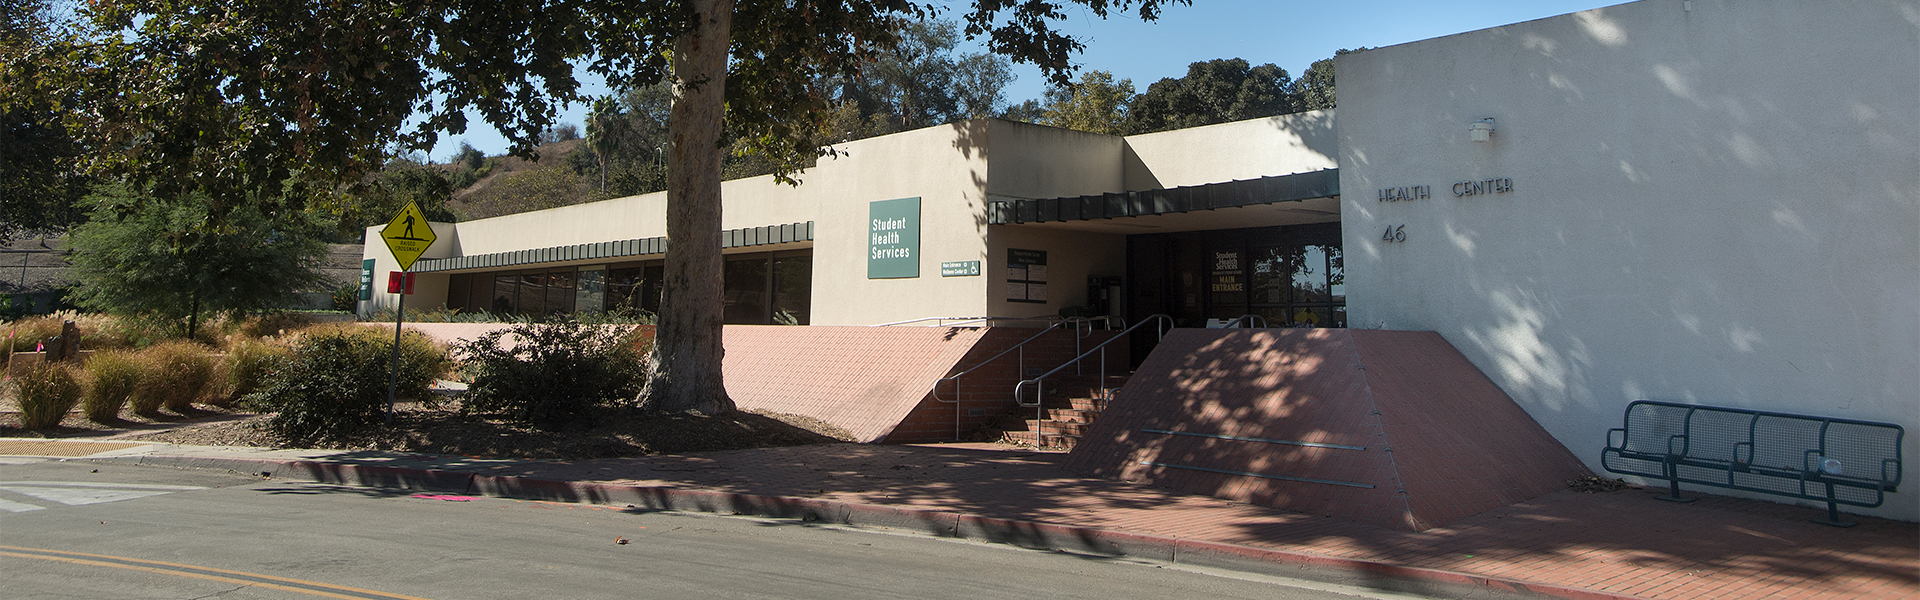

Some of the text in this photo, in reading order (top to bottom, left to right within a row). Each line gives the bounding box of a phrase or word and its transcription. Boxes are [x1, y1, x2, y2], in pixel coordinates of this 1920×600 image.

[1378, 177, 1513, 202] HEALTH CENTER
[872, 217, 906, 231] Student
[872, 231, 900, 245] Health
[1382, 224, 1406, 243] 46
[872, 245, 910, 260] Services
[1219, 258, 1238, 266] Health
[1213, 283, 1243, 291] ENTRANCE
